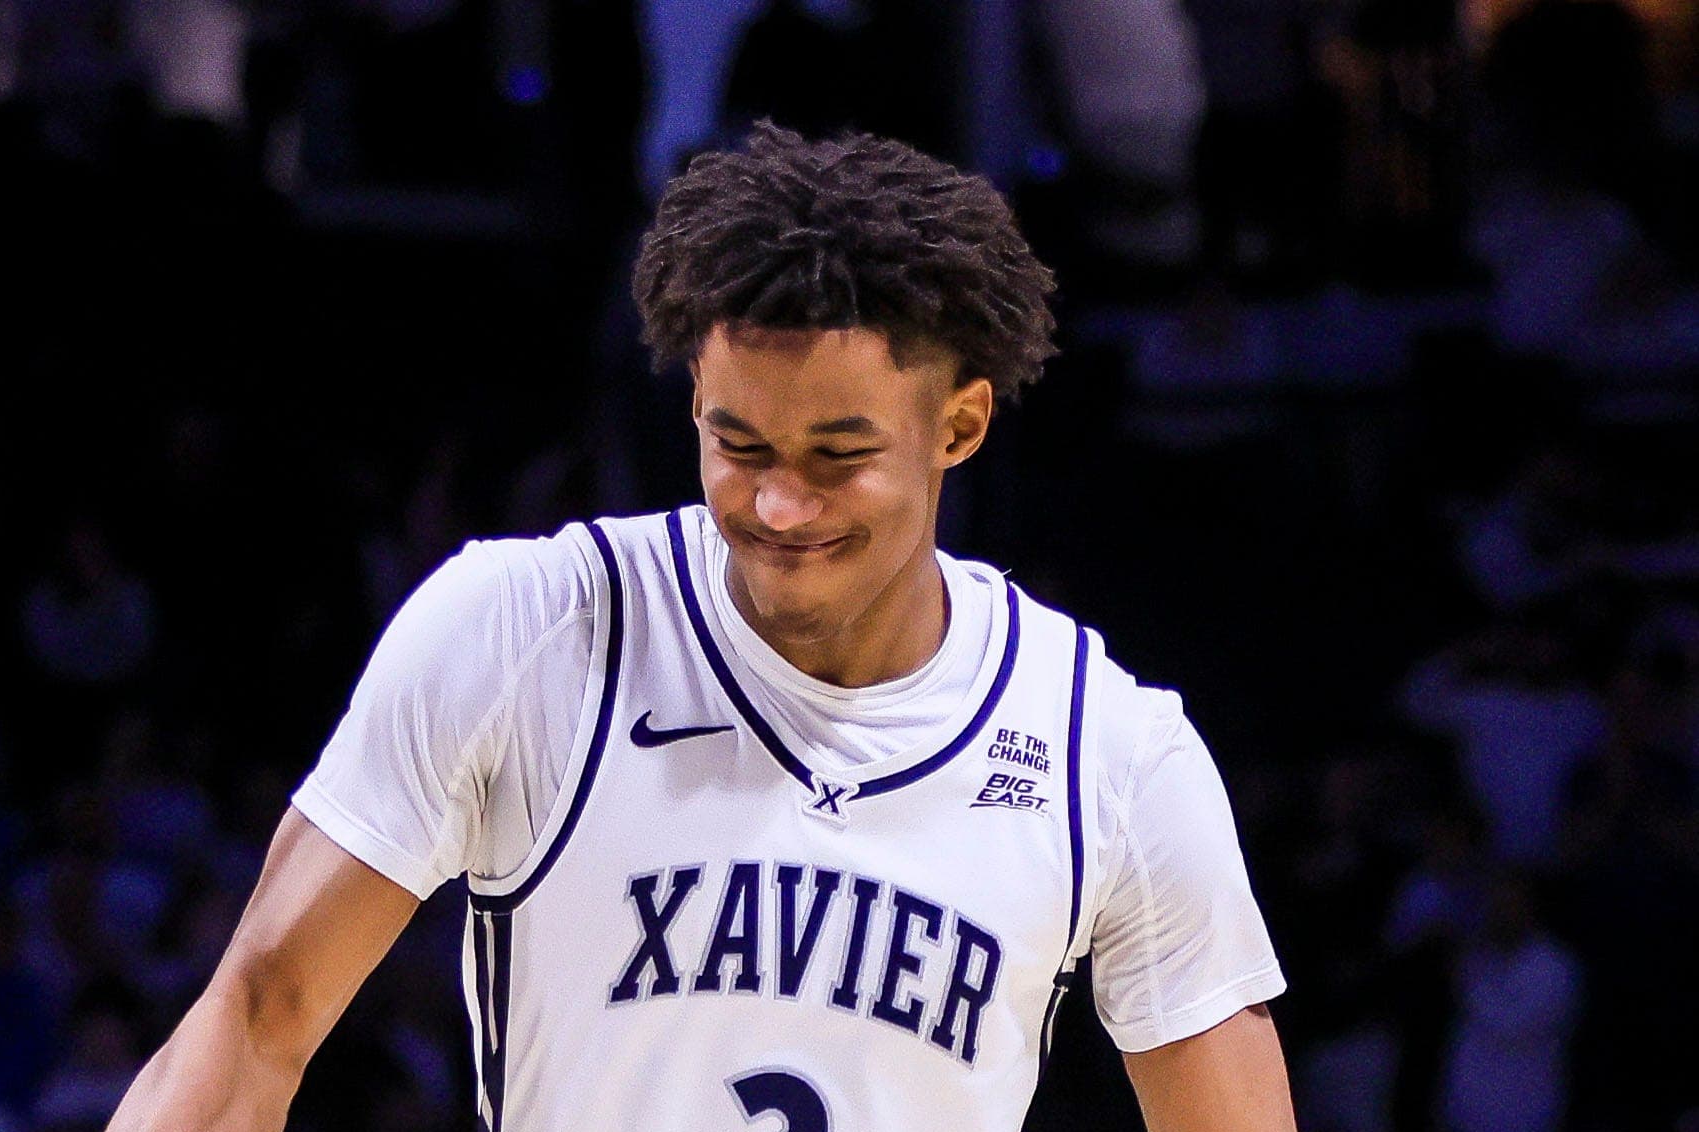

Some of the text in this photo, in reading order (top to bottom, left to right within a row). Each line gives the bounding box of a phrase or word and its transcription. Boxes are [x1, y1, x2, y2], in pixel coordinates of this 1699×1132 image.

[996, 728, 1049, 758] BE THE
[987, 743, 1051, 775] CHANGE
[986, 773, 1038, 793] BIG
[976, 788, 1049, 810] EAST
[605, 859, 1004, 1070] XAVIER
